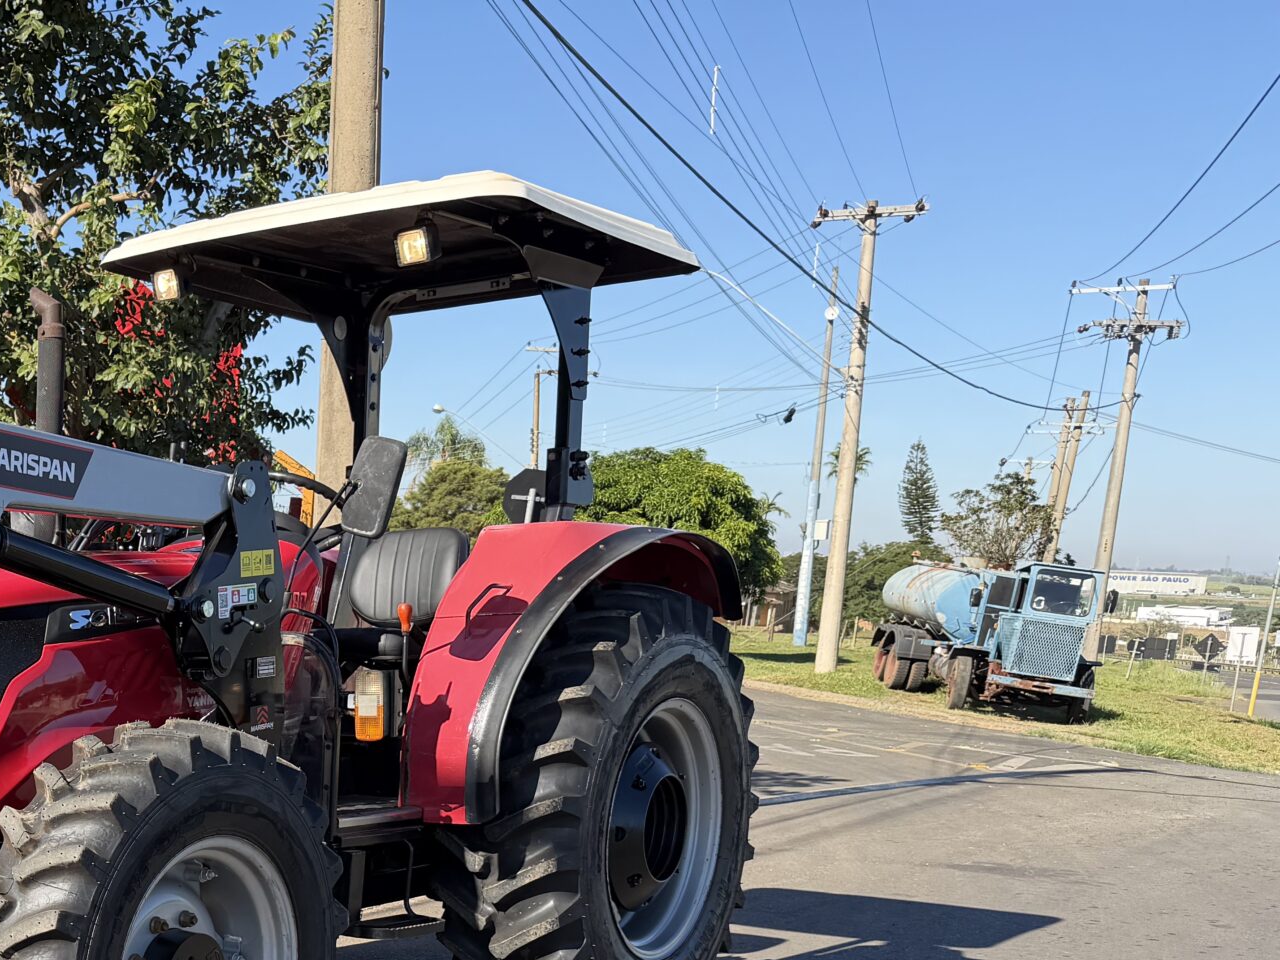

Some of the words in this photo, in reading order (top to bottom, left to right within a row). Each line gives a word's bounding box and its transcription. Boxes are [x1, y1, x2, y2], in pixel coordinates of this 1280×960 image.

[1140, 574, 1159, 582] SÃO
[1161, 576, 1190, 584] PAULO
[250, 722, 274, 733] MARISPAN
